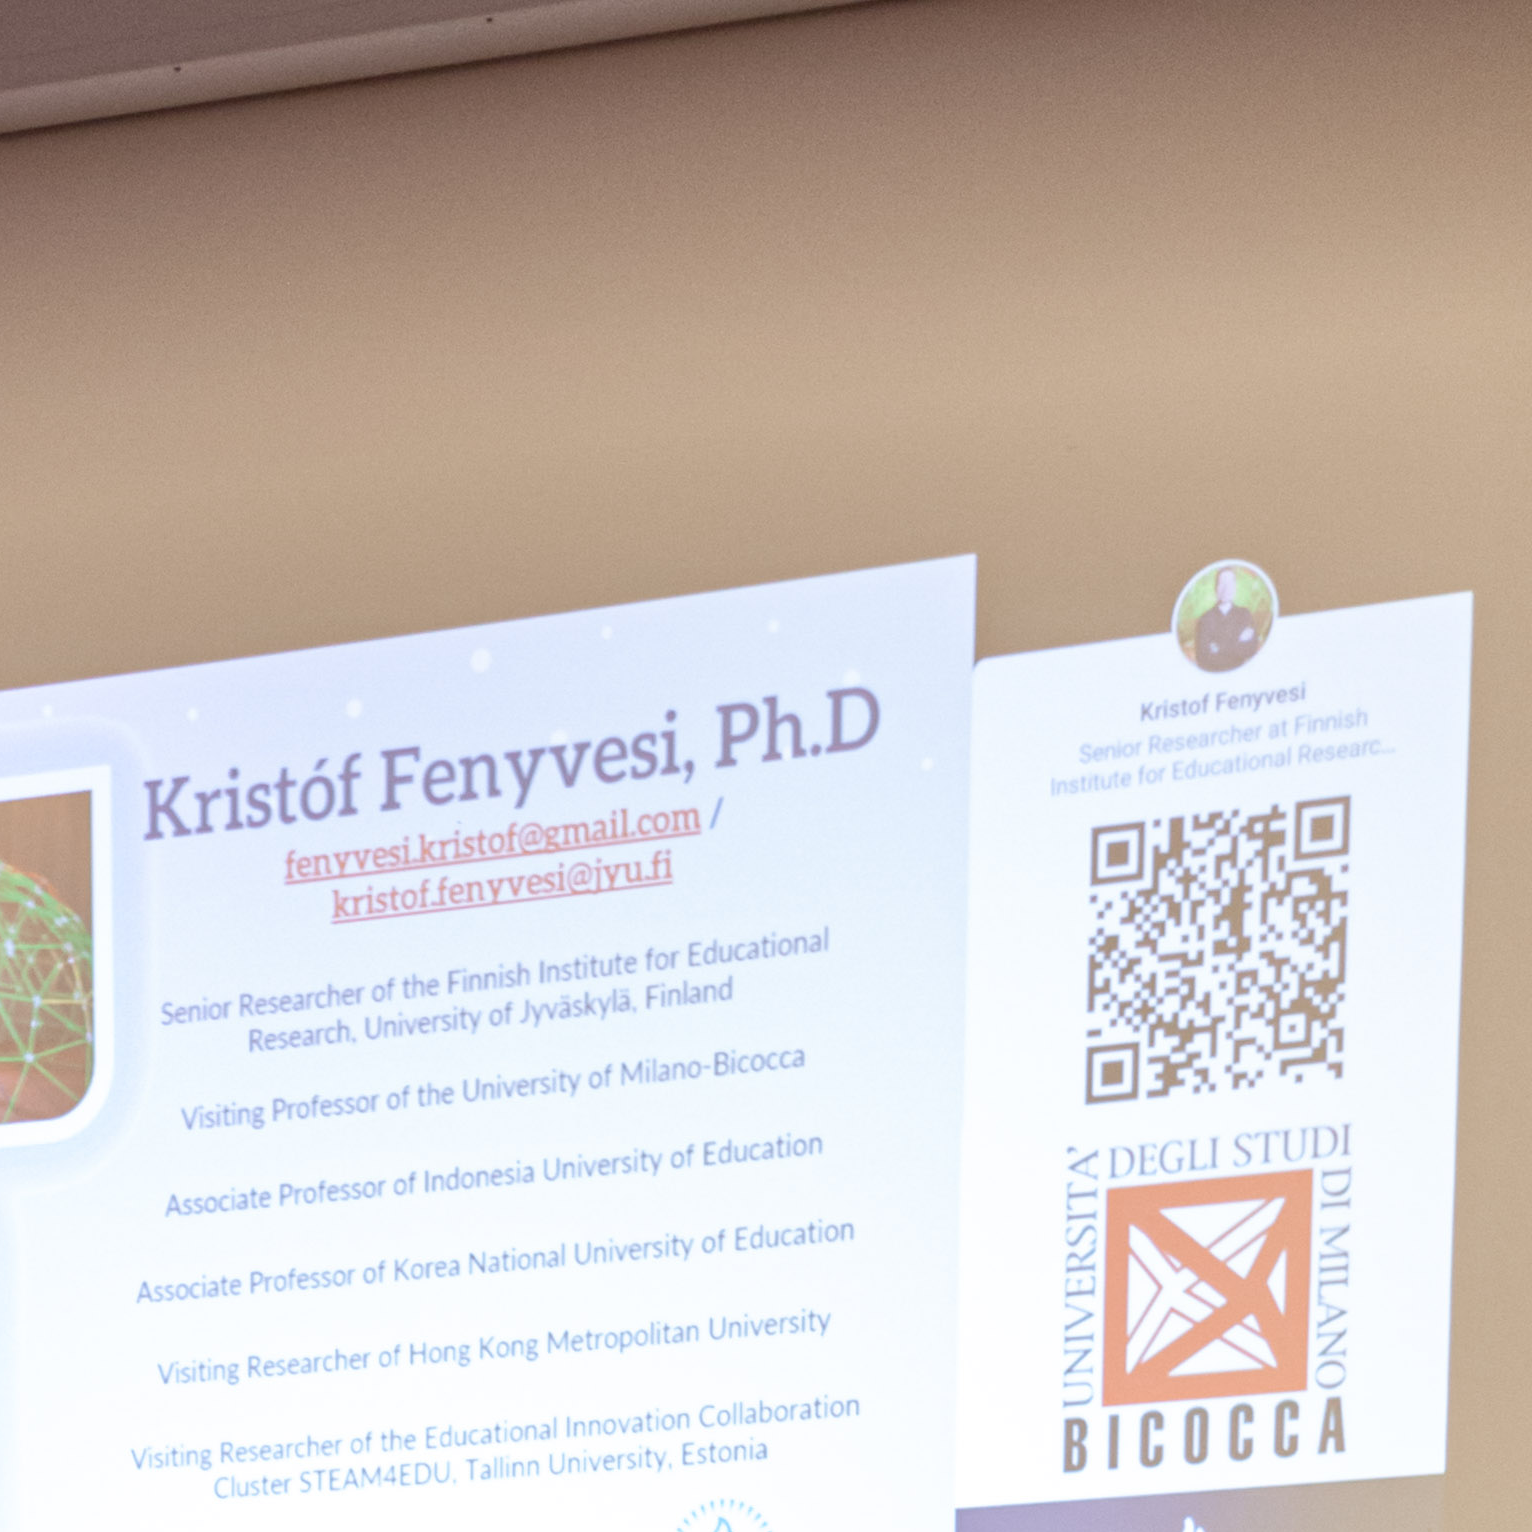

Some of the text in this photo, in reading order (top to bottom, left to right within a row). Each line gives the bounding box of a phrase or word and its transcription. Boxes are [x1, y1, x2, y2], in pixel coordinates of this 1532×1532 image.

[1080, 708, 1368, 763] Senior Researcher at Finnish
[1141, 682, 1306, 721] Kristof Fenyvesi
[144, 686, 880, 840] Kristóf Fenyvesi, Ph.D
[1052, 770, 1132, 795] Institute
[1139, 764, 1166, 784] for
[1173, 746, 1292, 780] Educational
[285, 797, 724, 885] fenyvesi.kristof@gmail.com /
[332, 849, 673, 924] kristof.fenyvesi@jyu.fi
[162, 926, 829, 1025] Senior Researcher of the Finnish Institute for Educational
[250, 975, 733, 1052] Research, University of Jyväskylä, Finland
[182, 1048, 805, 1130] Visiting Professor of the University of Milano-Bicocca
[166, 1132, 823, 1217] Associate Professor of Indonesia University of Education
[1108, 1122, 1352, 1179] DEGLI STUDI
[137, 1218, 855, 1303] Associate Professor of Korea National University of Education
[1314, 1166, 1353, 1391] DI MILANO
[158, 1308, 831, 1385] Visiting Researcher of Hong Kong Metropolitan University
[132, 1394, 860, 1470] Visiting Researcher of the Educational Innovation Collaboration
[215, 1436, 768, 1499] Cluster STEAM4EDU, Tallinn University, Estonia
[1063, 1396, 1347, 1474] BICOCCA
